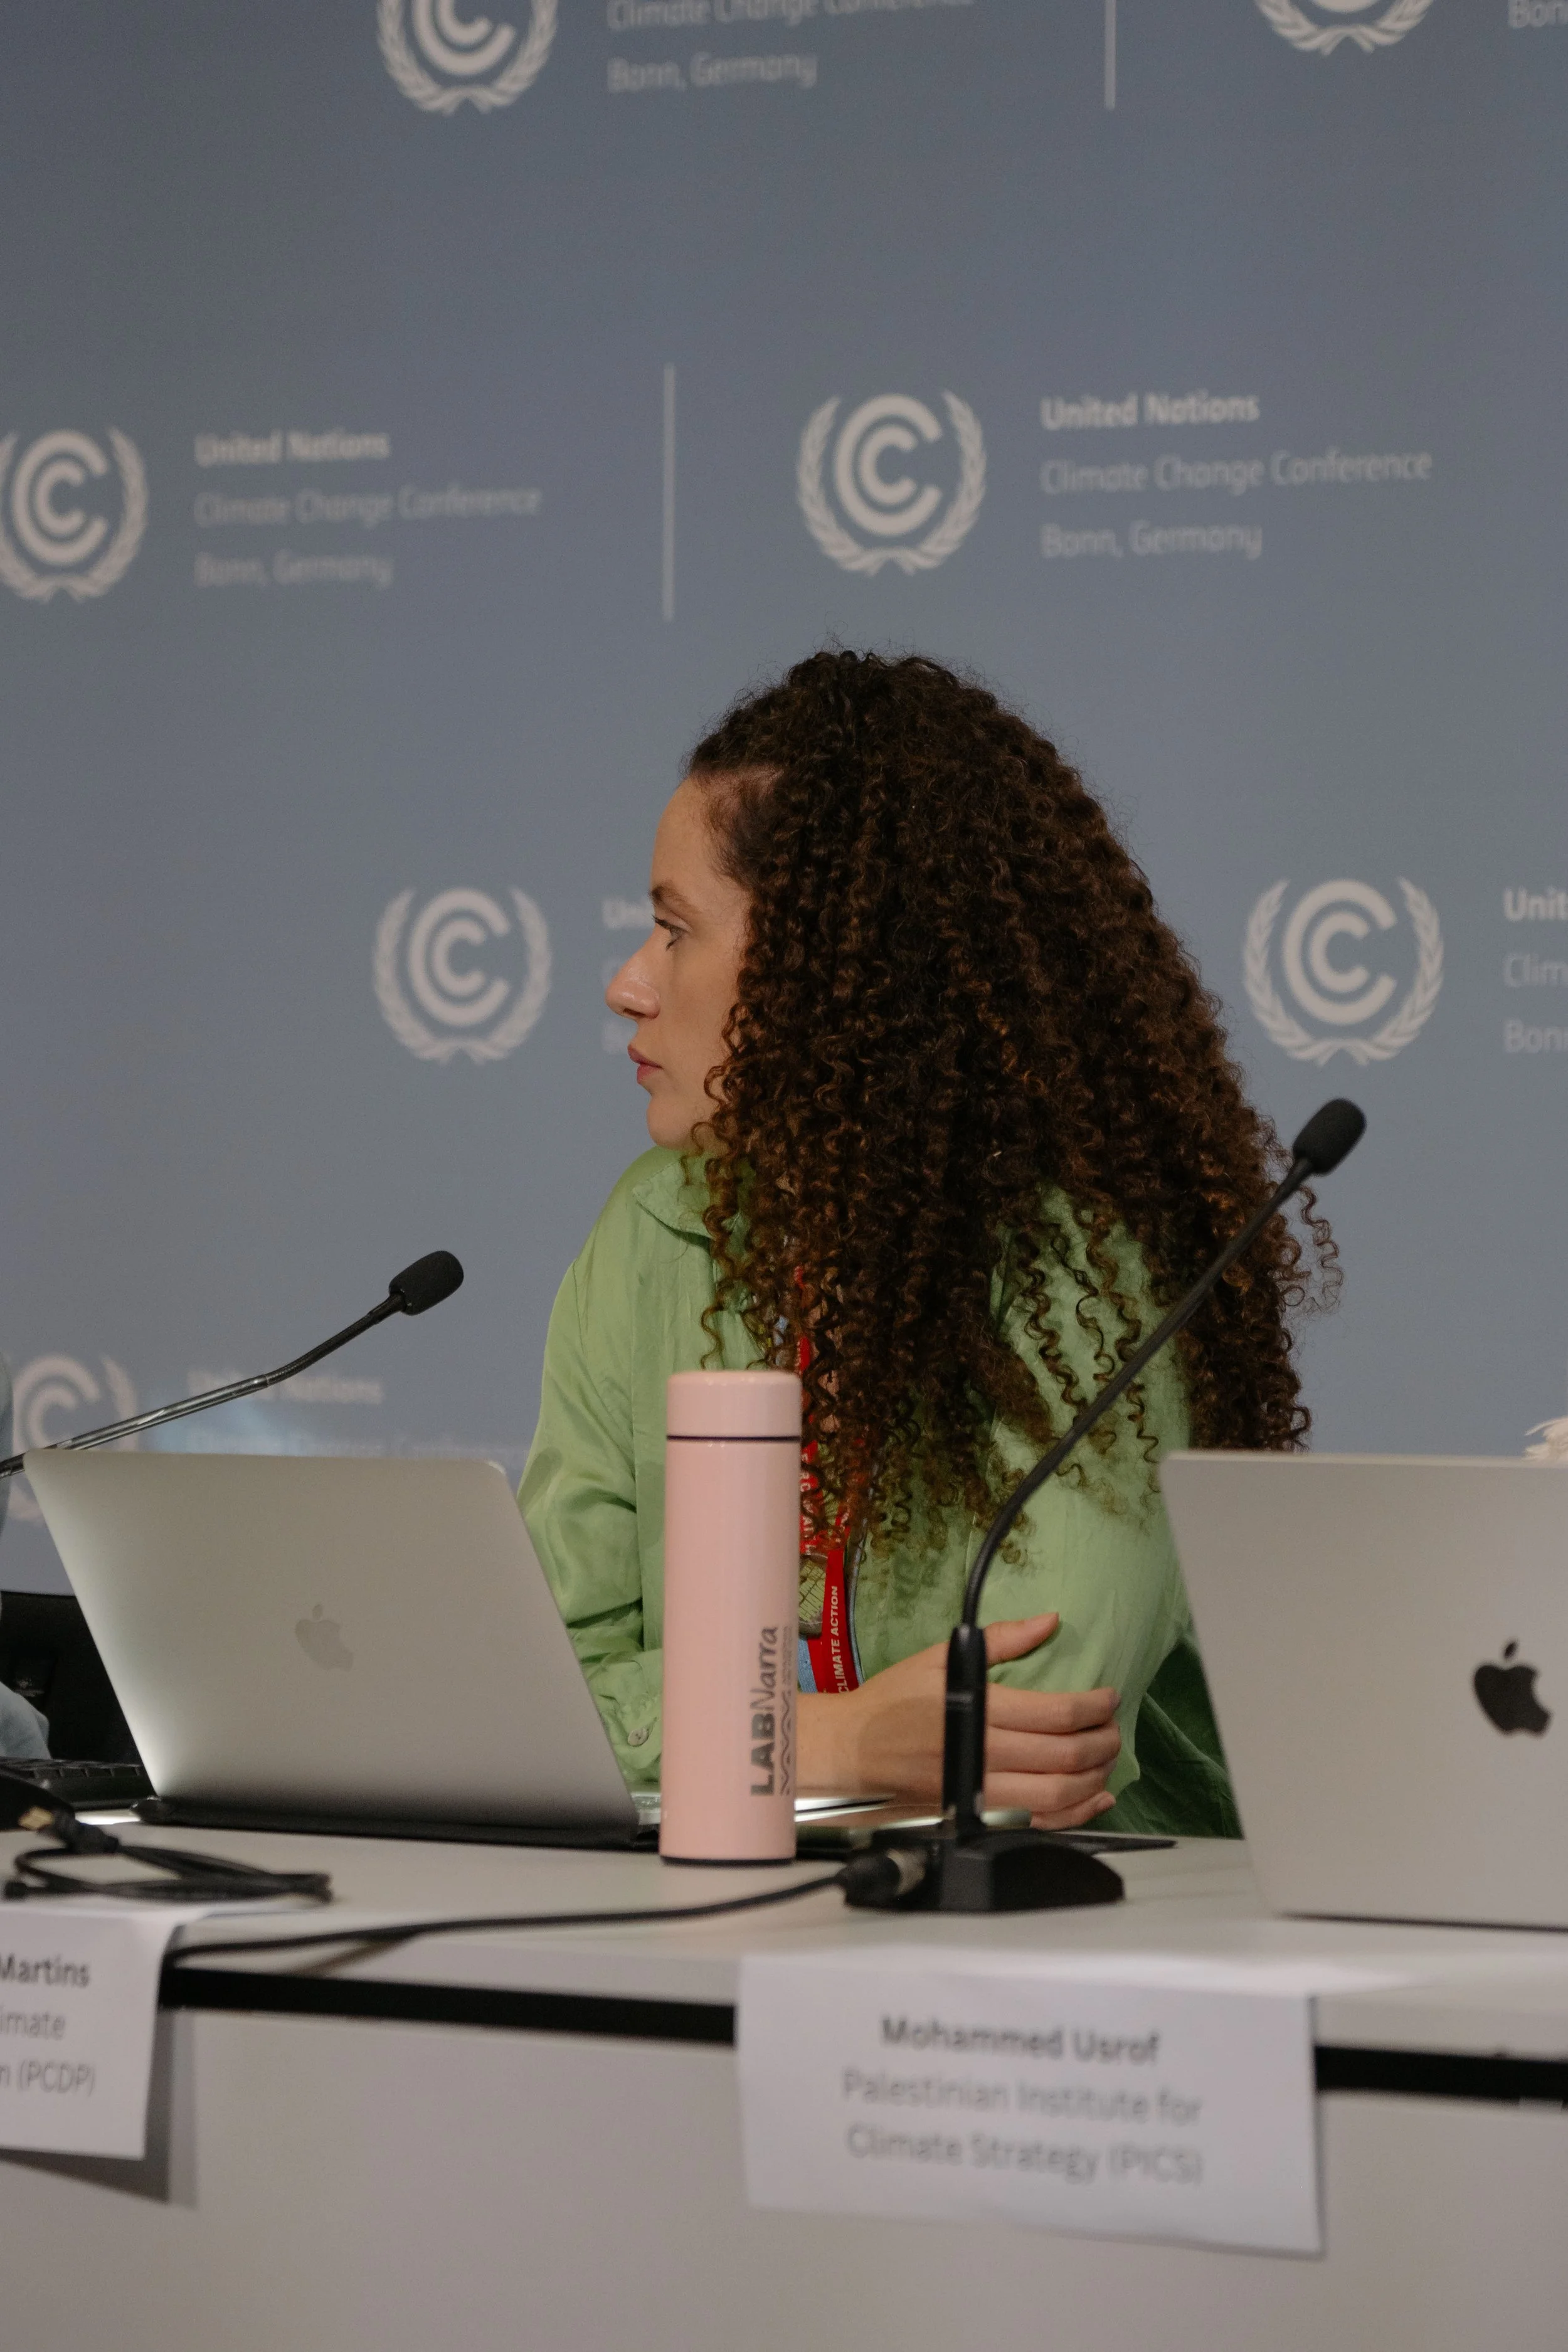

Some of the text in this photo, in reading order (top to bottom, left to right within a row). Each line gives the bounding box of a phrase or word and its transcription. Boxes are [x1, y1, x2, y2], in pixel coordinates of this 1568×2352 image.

[691, 52, 817, 88] Germany
[1041, 389, 1259, 430] United Nations
[194, 428, 389, 466] United Nations
[1040, 447, 1432, 495] Climate Change Conference
[194, 481, 542, 528] Climate Change Conference
[1041, 520, 1262, 559] Bonn, Germany
[273, 549, 393, 590] Germany
[830, 1585, 850, 1693] CLIMATE ACTION
[881, 2015, 1160, 2065] Mohammed Usrof
[18, 2058, 97, 2098] (PCDP)
[843, 2068, 1201, 2124] Palestinian Institute for
[846, 2123, 1202, 2184] Climate Strategy (PICS)
